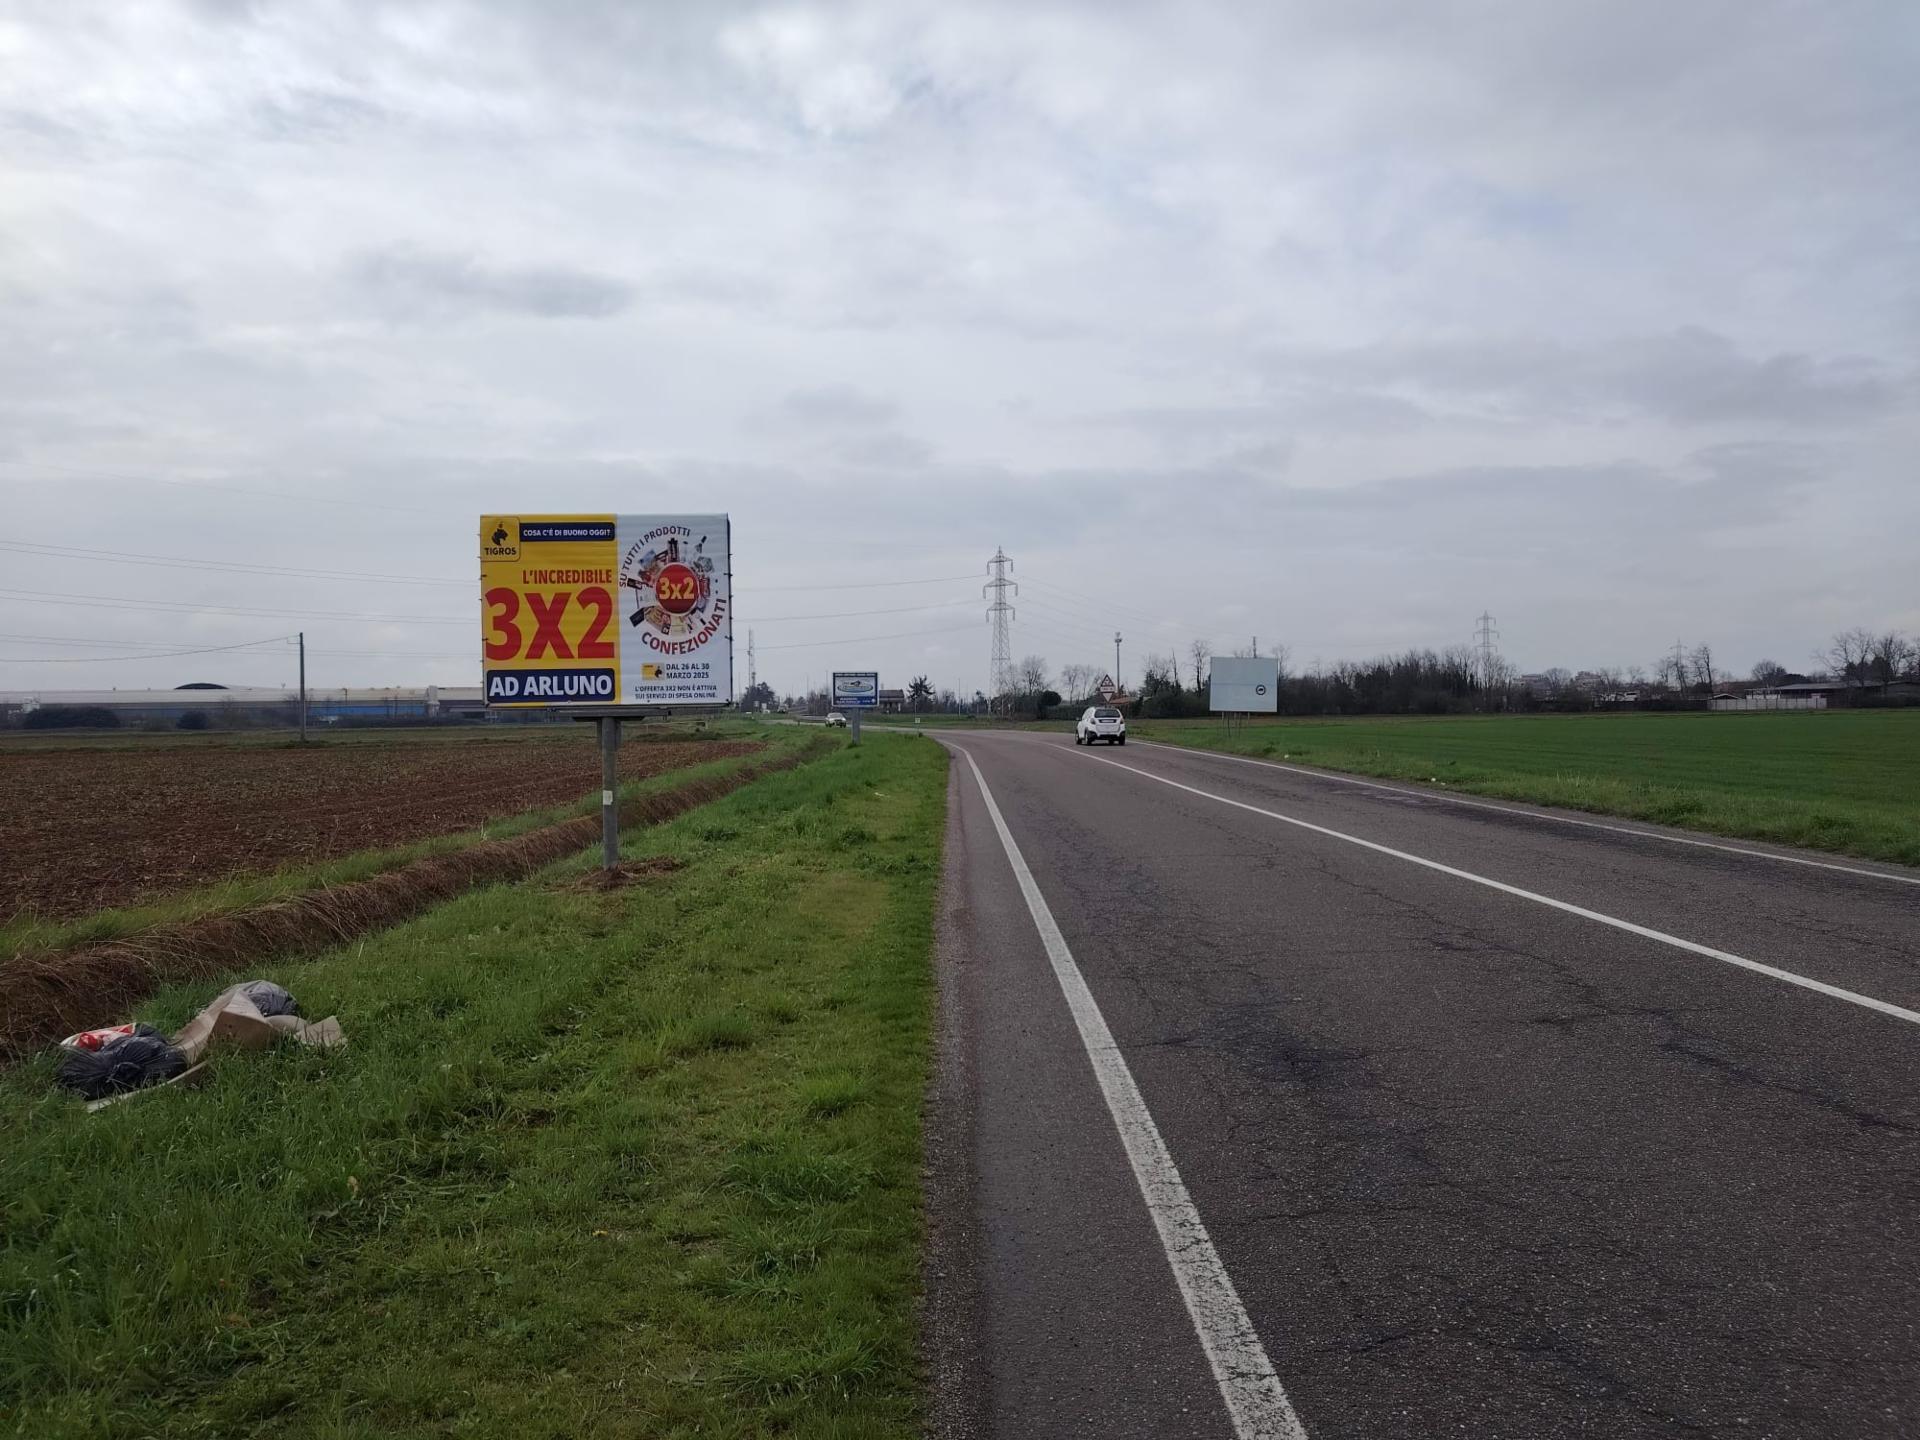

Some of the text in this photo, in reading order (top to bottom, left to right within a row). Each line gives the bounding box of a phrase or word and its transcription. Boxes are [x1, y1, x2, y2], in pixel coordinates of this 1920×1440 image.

[523, 529, 541, 537] COSA
[554, 529, 562, 537] DI
[563, 528, 588, 536] BUONO
[644, 526, 690, 543] PRODOTTI
[484, 547, 517, 556] TIGROS
[622, 543, 641, 570] TUTTI
[522, 569, 612, 584] L'INCREDIBILE
[619, 572, 628, 588] SU
[659, 577, 694, 600] 3x2
[485, 586, 615, 661] 3X2
[641, 598, 727, 655] CONFEZIONATI
[489, 675, 612, 697] AD ARLUNO
